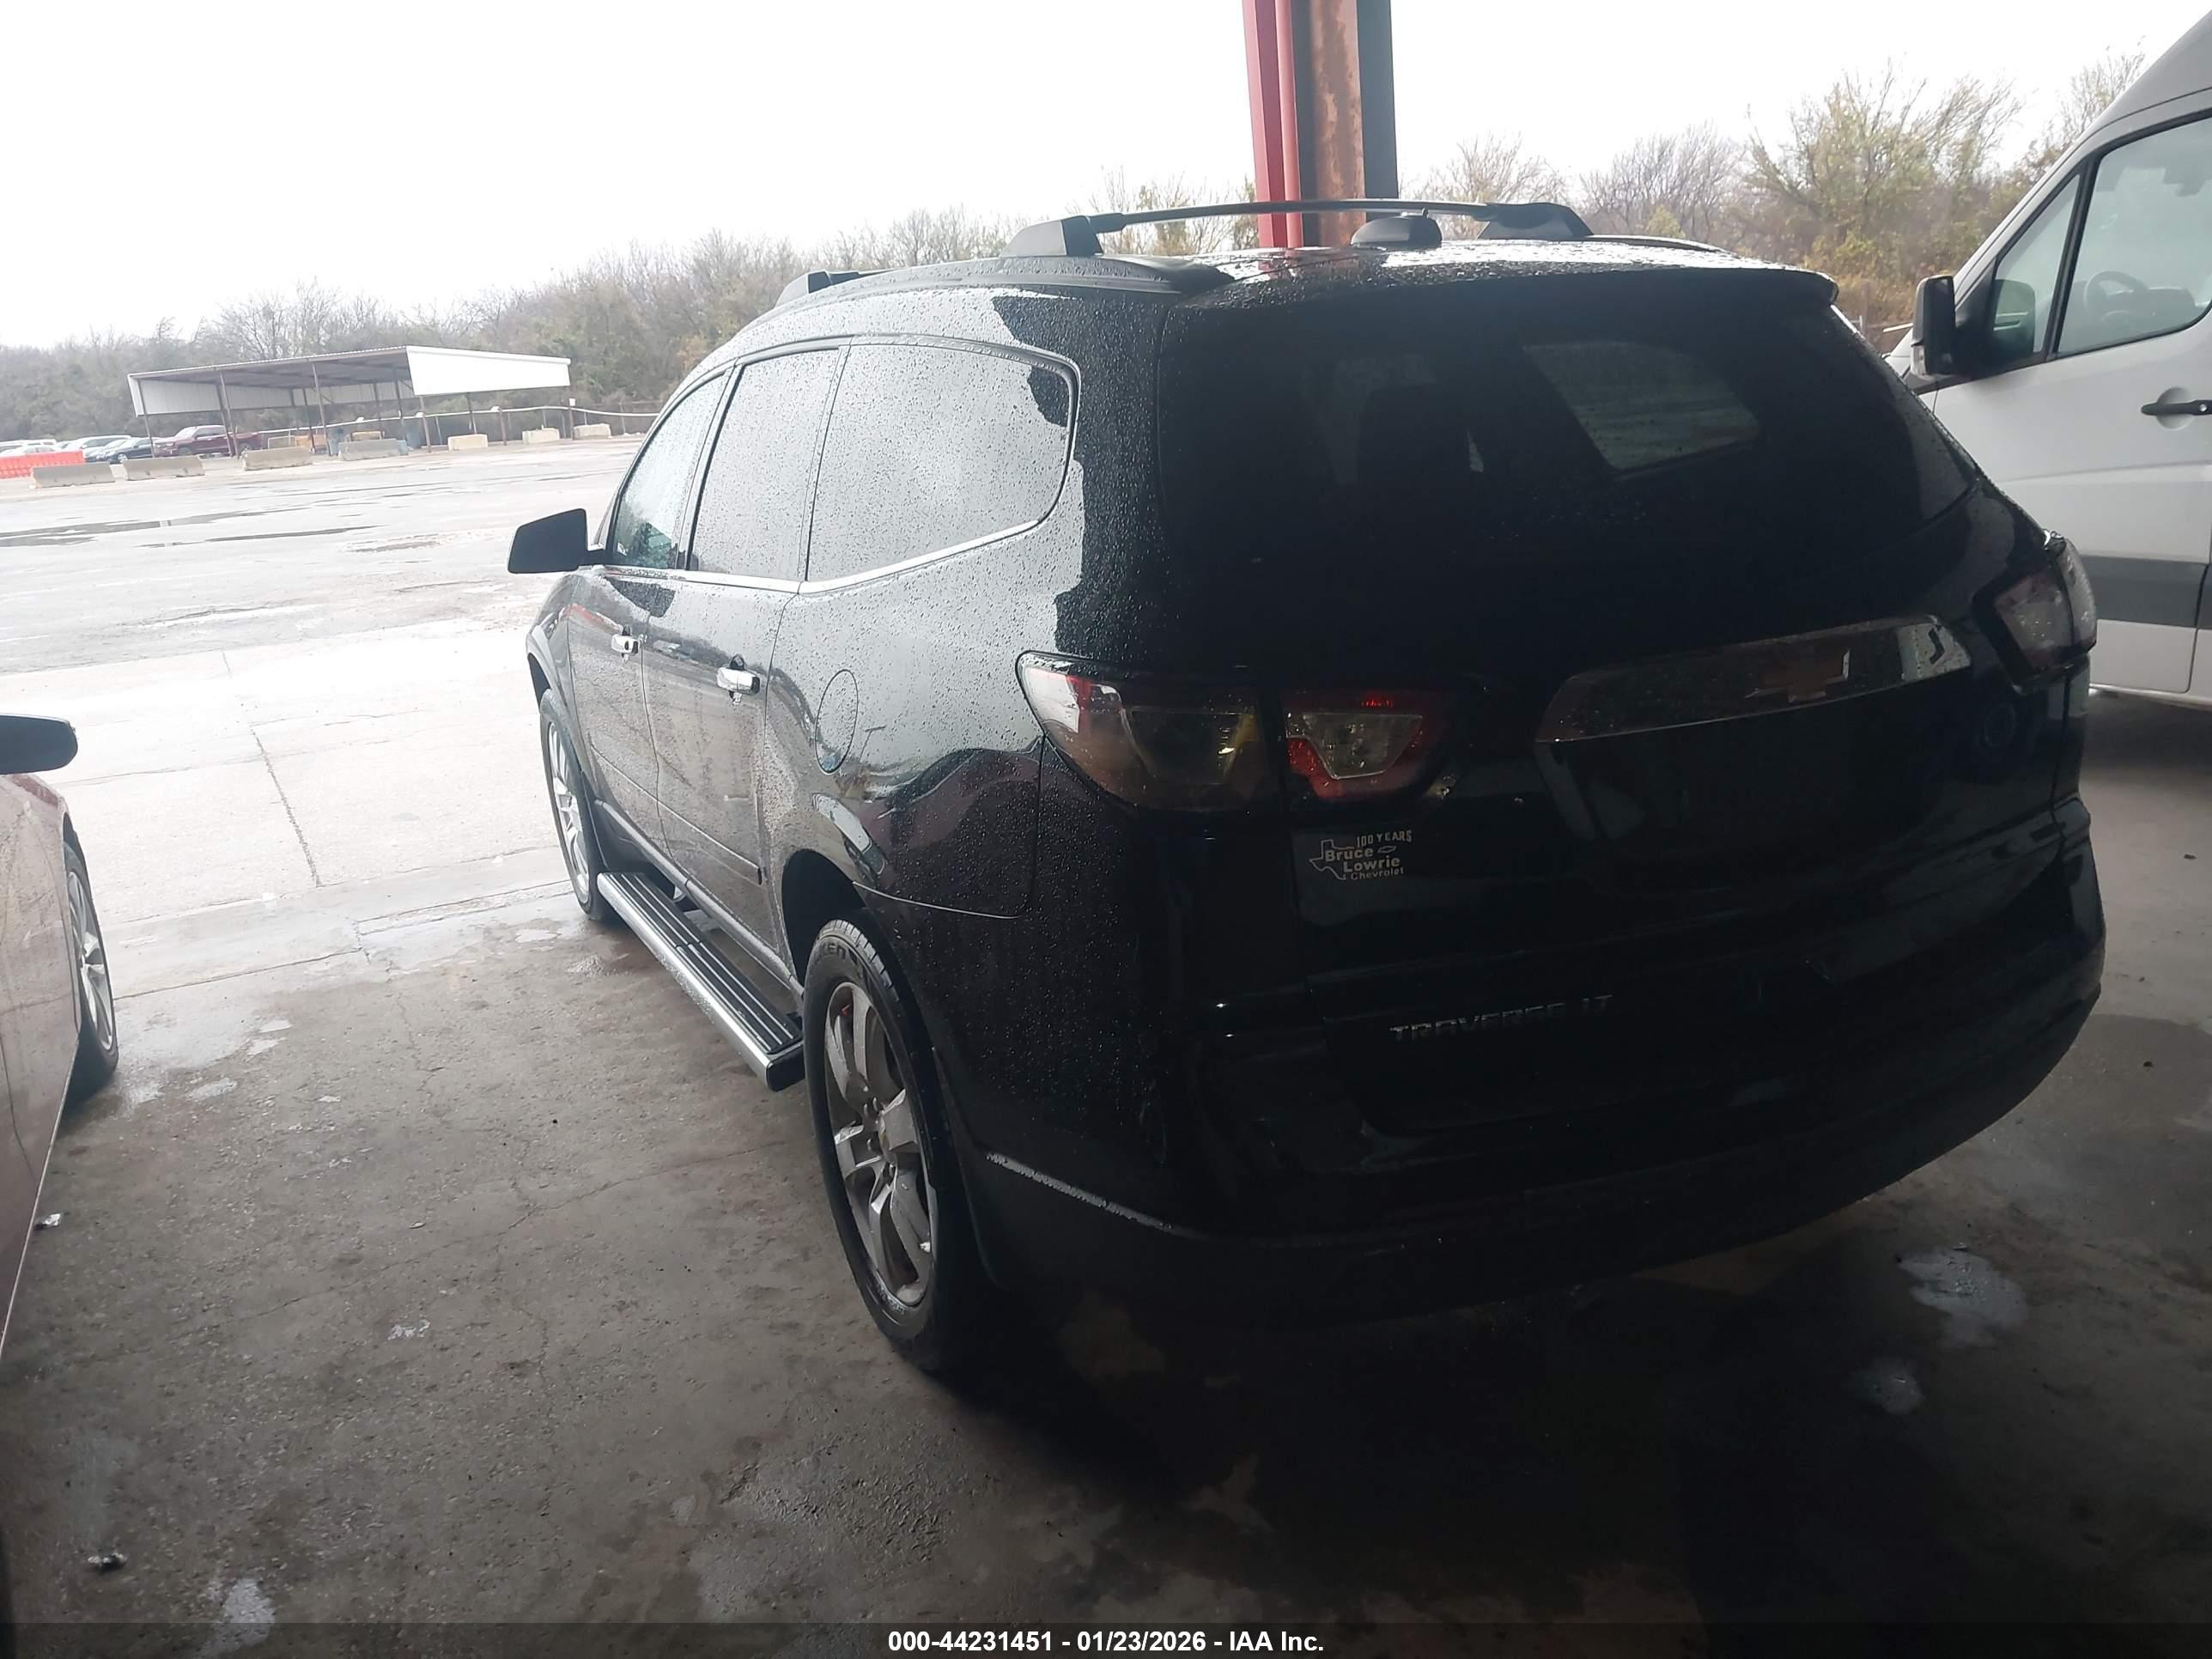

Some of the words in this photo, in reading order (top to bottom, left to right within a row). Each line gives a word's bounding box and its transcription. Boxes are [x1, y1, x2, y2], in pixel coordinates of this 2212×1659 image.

[1357, 833, 1374, 848] 100
[1376, 830, 1413, 843] YEARS
[1324, 847, 1374, 862] Bruce
[1343, 854, 1401, 872] Lowrie
[1351, 866, 1405, 881] Chevrolet
